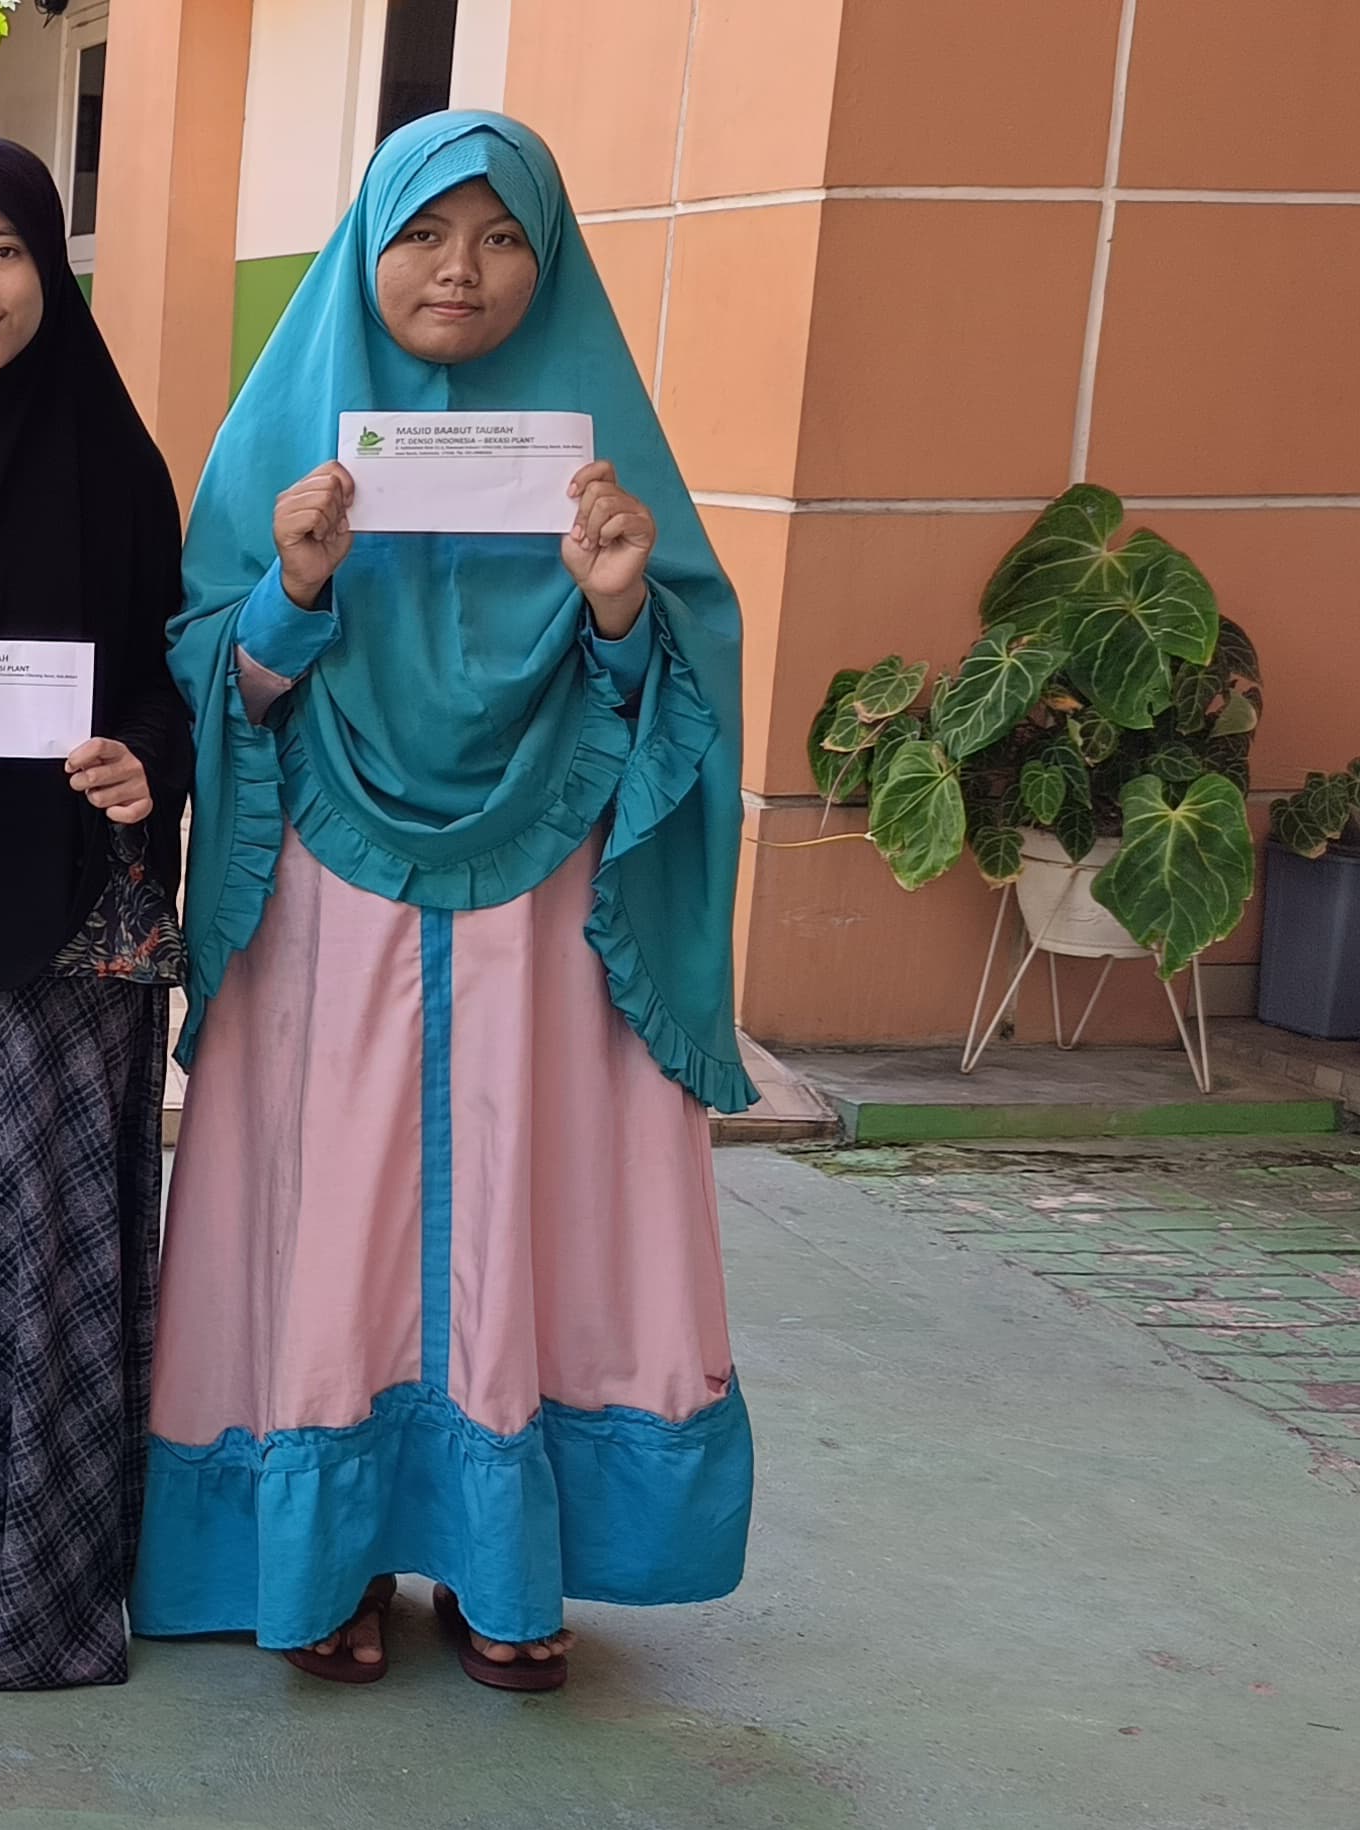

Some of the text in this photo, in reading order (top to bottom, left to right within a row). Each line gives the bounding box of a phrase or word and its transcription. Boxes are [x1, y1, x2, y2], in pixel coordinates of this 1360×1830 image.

[396, 426, 513, 435] MASJID BAABUT TAUBAH
